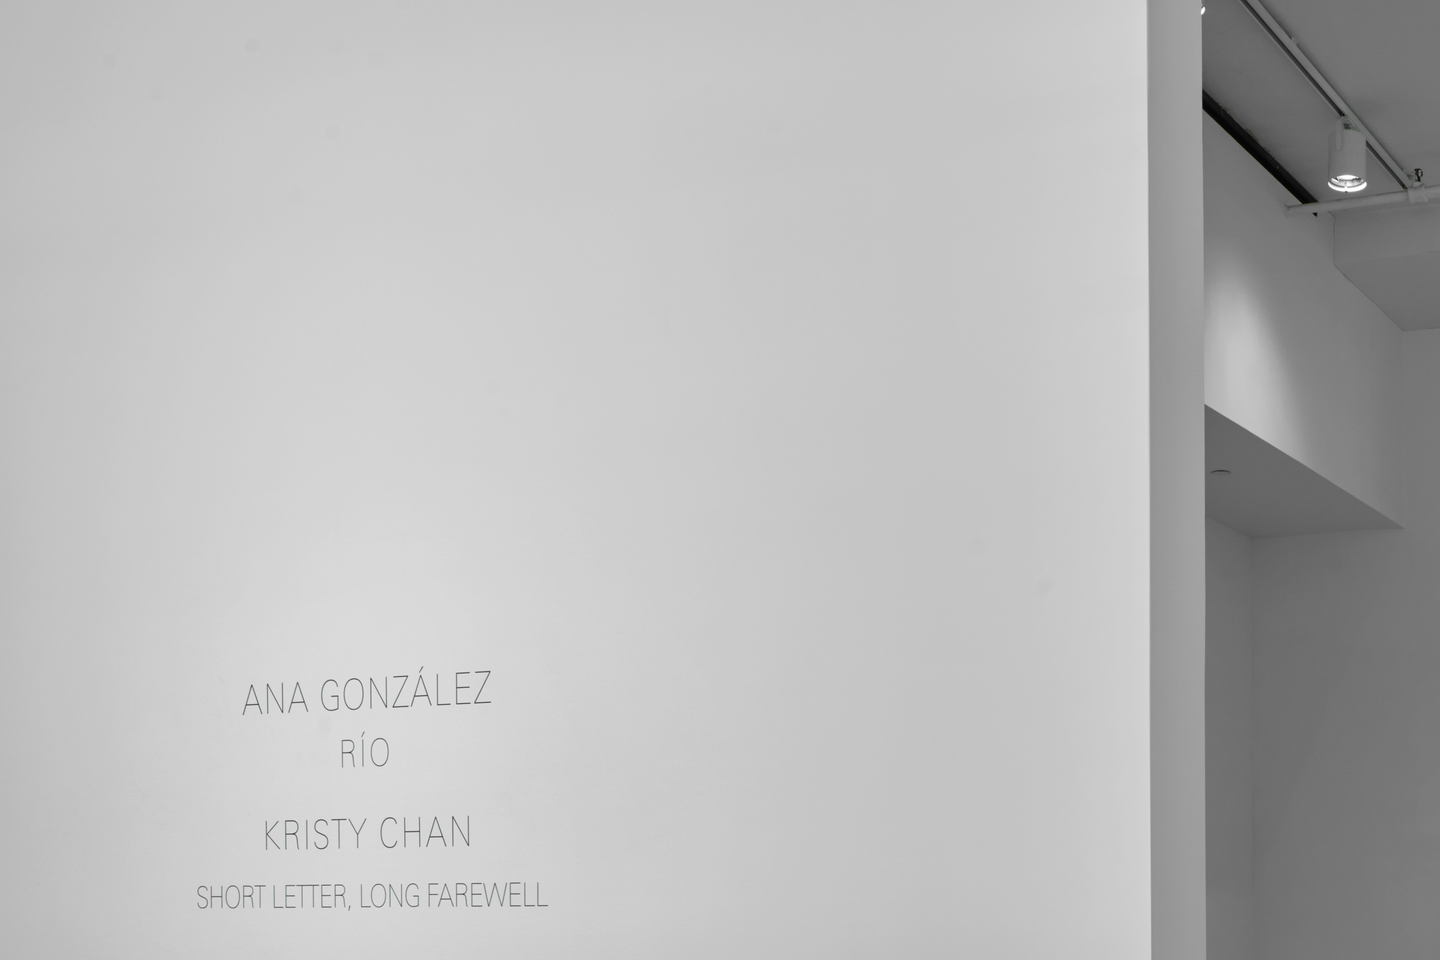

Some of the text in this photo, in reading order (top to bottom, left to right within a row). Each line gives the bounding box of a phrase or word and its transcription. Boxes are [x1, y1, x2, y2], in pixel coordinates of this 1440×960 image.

[241, 665, 492, 716] ANA GONZÁLEZ
[341, 731, 390, 768] RÍO
[264, 815, 470, 851] KRISTY CHAN
[196, 881, 549, 912] SHORT LETTER, LONG FAREWELL
